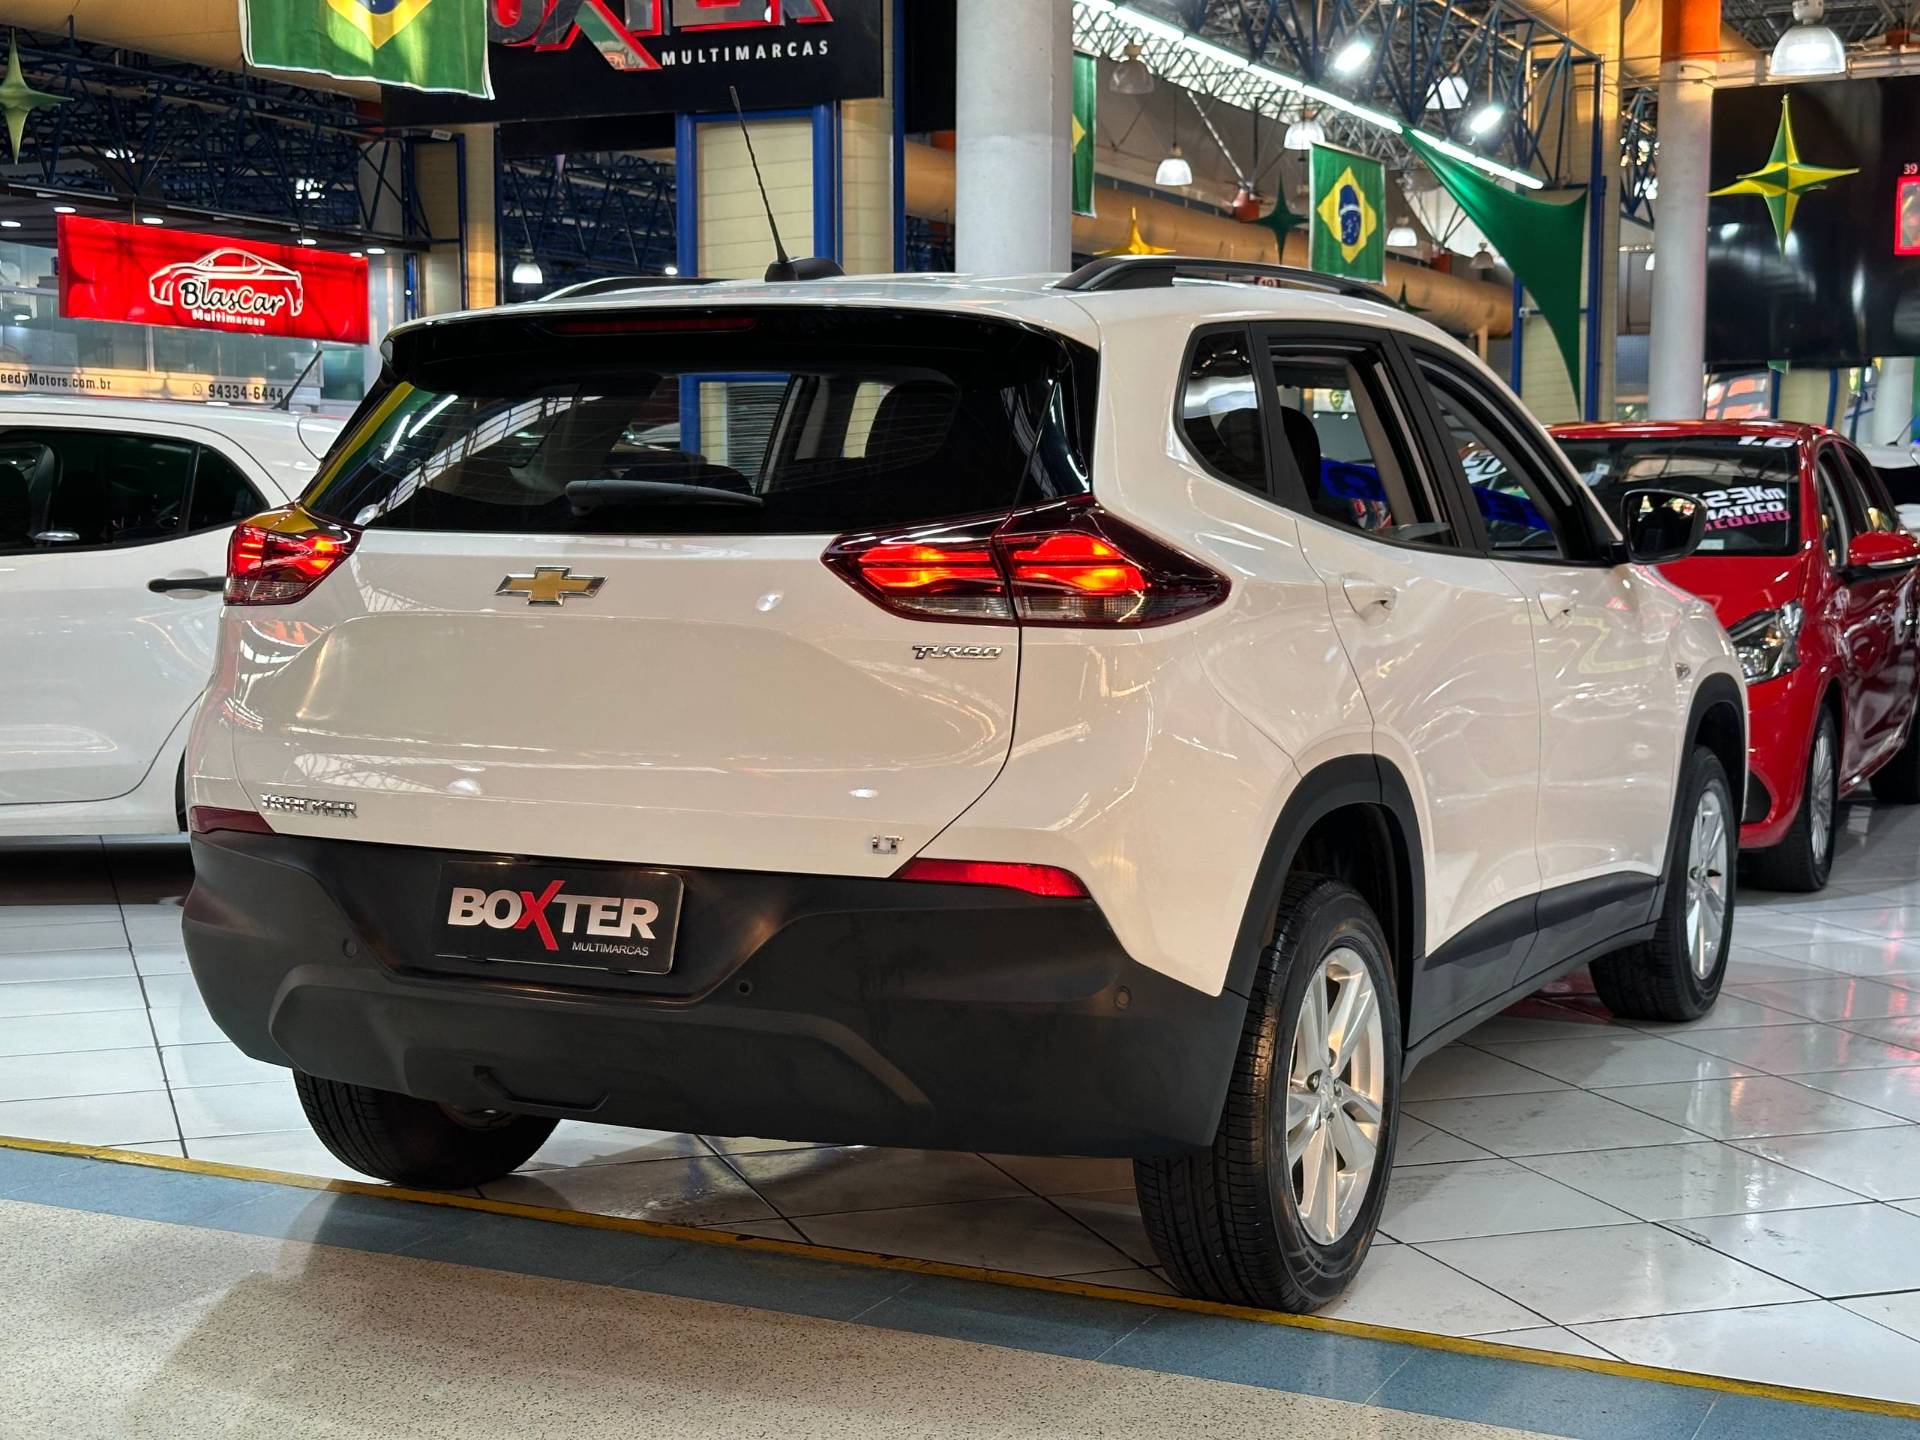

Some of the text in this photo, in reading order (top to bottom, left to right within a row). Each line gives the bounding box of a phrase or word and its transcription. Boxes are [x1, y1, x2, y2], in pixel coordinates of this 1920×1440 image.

[661, 40, 829, 67] MULTIMARCAS
[179, 280, 285, 314] BlasCar
[191, 309, 265, 326] Multimarcas
[208, 383, 284, 402] 94334-6444
[912, 646, 1003, 660] TURBO
[260, 793, 357, 818] TRACKER
[872, 835, 904, 854] LT
[448, 880, 657, 951] BOXTER
[572, 941, 649, 956] MULTIMARCAS
